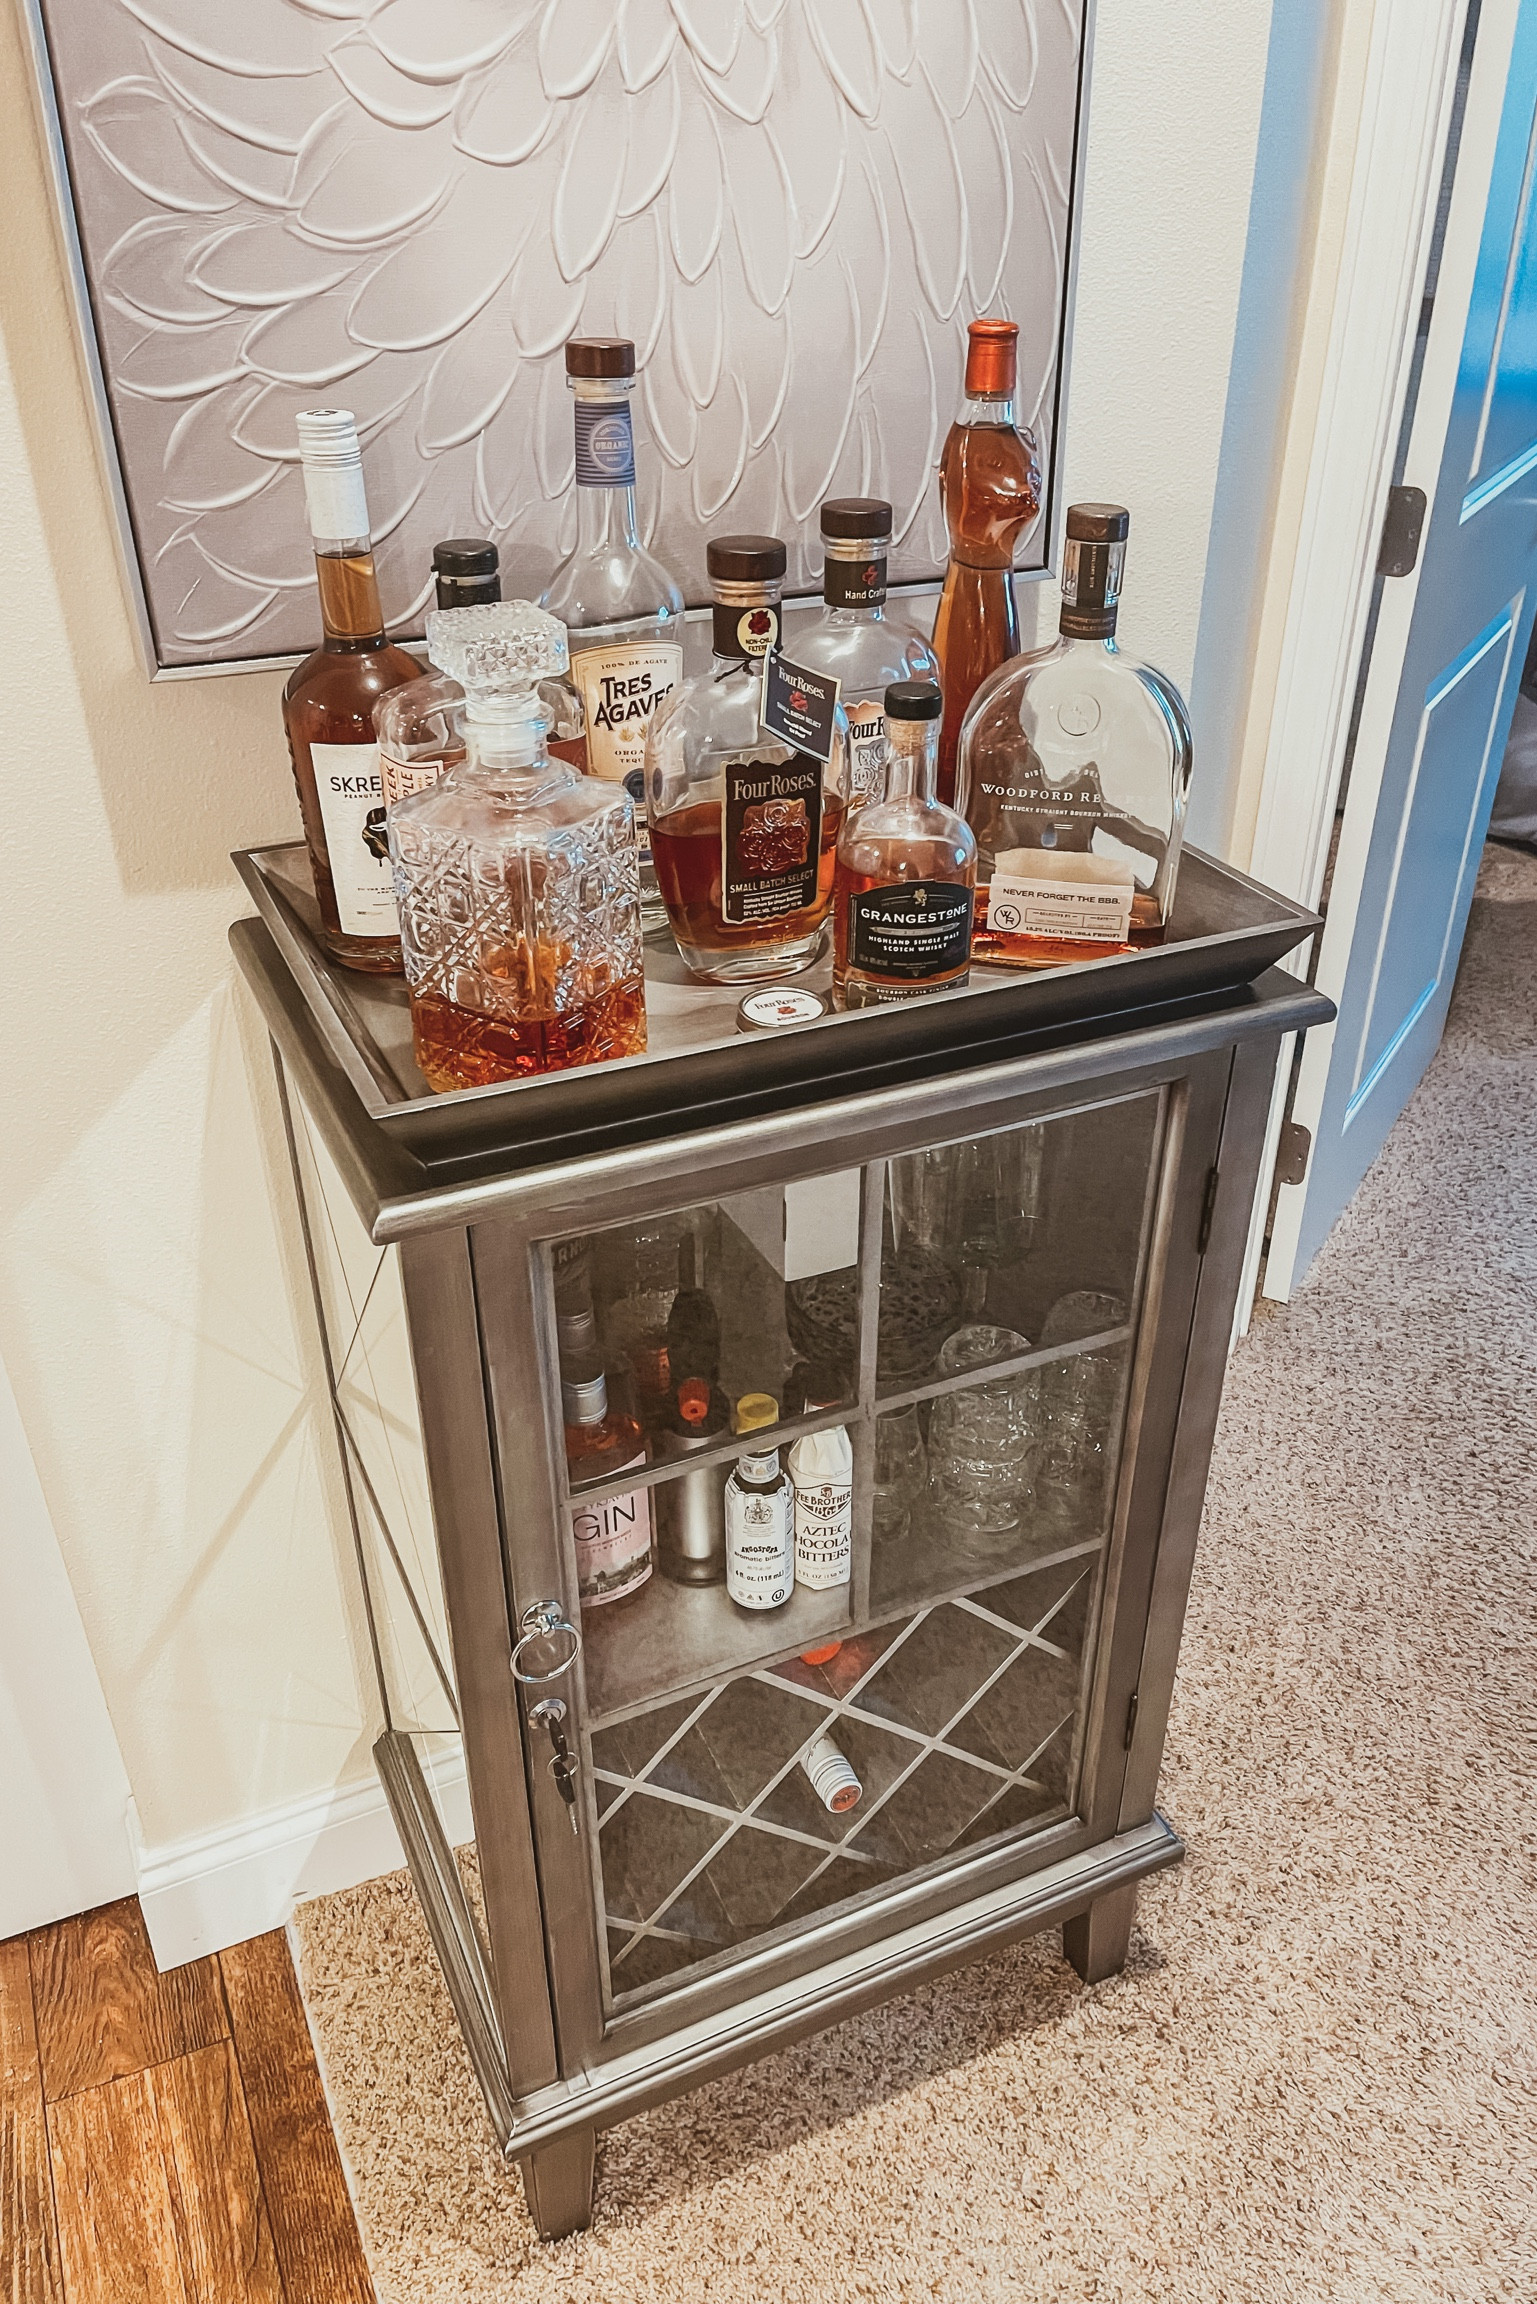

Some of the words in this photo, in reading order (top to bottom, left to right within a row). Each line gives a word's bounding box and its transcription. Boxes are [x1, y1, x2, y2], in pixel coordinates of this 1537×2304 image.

[845, 590, 867, 600] Hand
[601, 662, 625, 670] 100%
[600, 673, 652, 709] TRES
[733, 779, 771, 801] Four
[981, 783, 1073, 803] WOODFORD
[1000, 804, 1034, 813] KENTUCKY
[1035, 807, 1068, 816] STRAIGHT
[729, 883, 758, 894] SMALL
[759, 877, 786, 890] BATCH
[787, 869, 814, 884] SELECT
[1003, 888, 1035, 898] NEVER
[1036, 892, 1075, 902] FORGET
[860, 903, 967, 924] GRANGESTONE
[868, 936, 910, 946] HIGHLAND
[913, 936, 941, 946] SINGLE
[943, 931, 960, 941] MALT
[883, 945, 915, 953] SCOTCH
[917, 943, 948, 952] WHISKY
[796, 1490, 809, 1504] FEE
[573, 1496, 636, 1542] GIN
[803, 1522, 847, 1537] AZTEC
[734, 1551, 763, 1563] aromatic
[764, 1551, 786, 1562] bitters
[741, 1546, 778, 1554] ANGOSTURA
[798, 1545, 850, 1562] BITTERS
